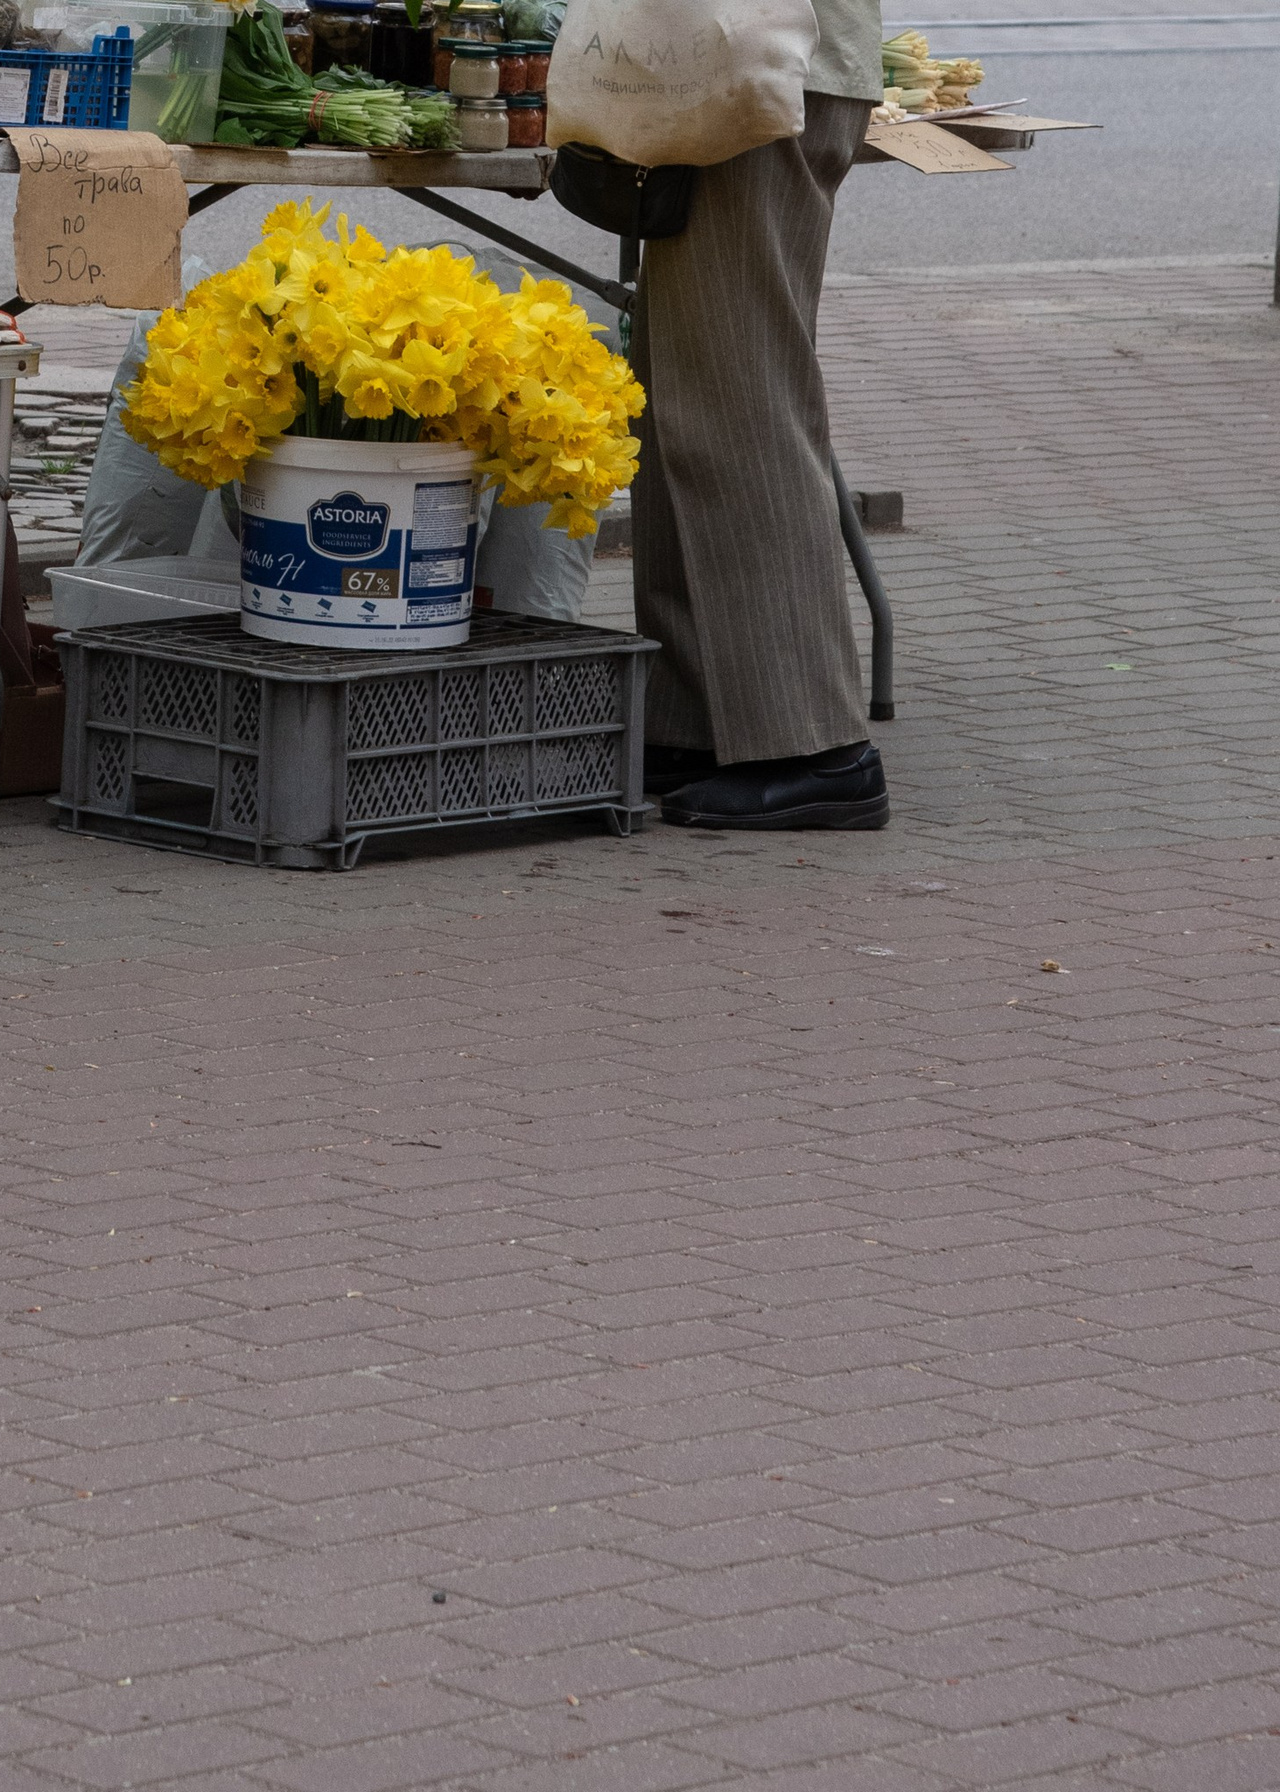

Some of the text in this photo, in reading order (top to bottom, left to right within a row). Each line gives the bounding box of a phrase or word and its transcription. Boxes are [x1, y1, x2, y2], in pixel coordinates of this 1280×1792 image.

[592, 75, 666, 95] медицина
[74, 165, 144, 204] трава
[63, 214, 86, 235] по
[313, 507, 383, 524] ASTORIA
[322, 531, 372, 540] FOODSERVICE
[322, 539, 372, 548] INGREDIENTS
[348, 571, 390, 591] 67%
